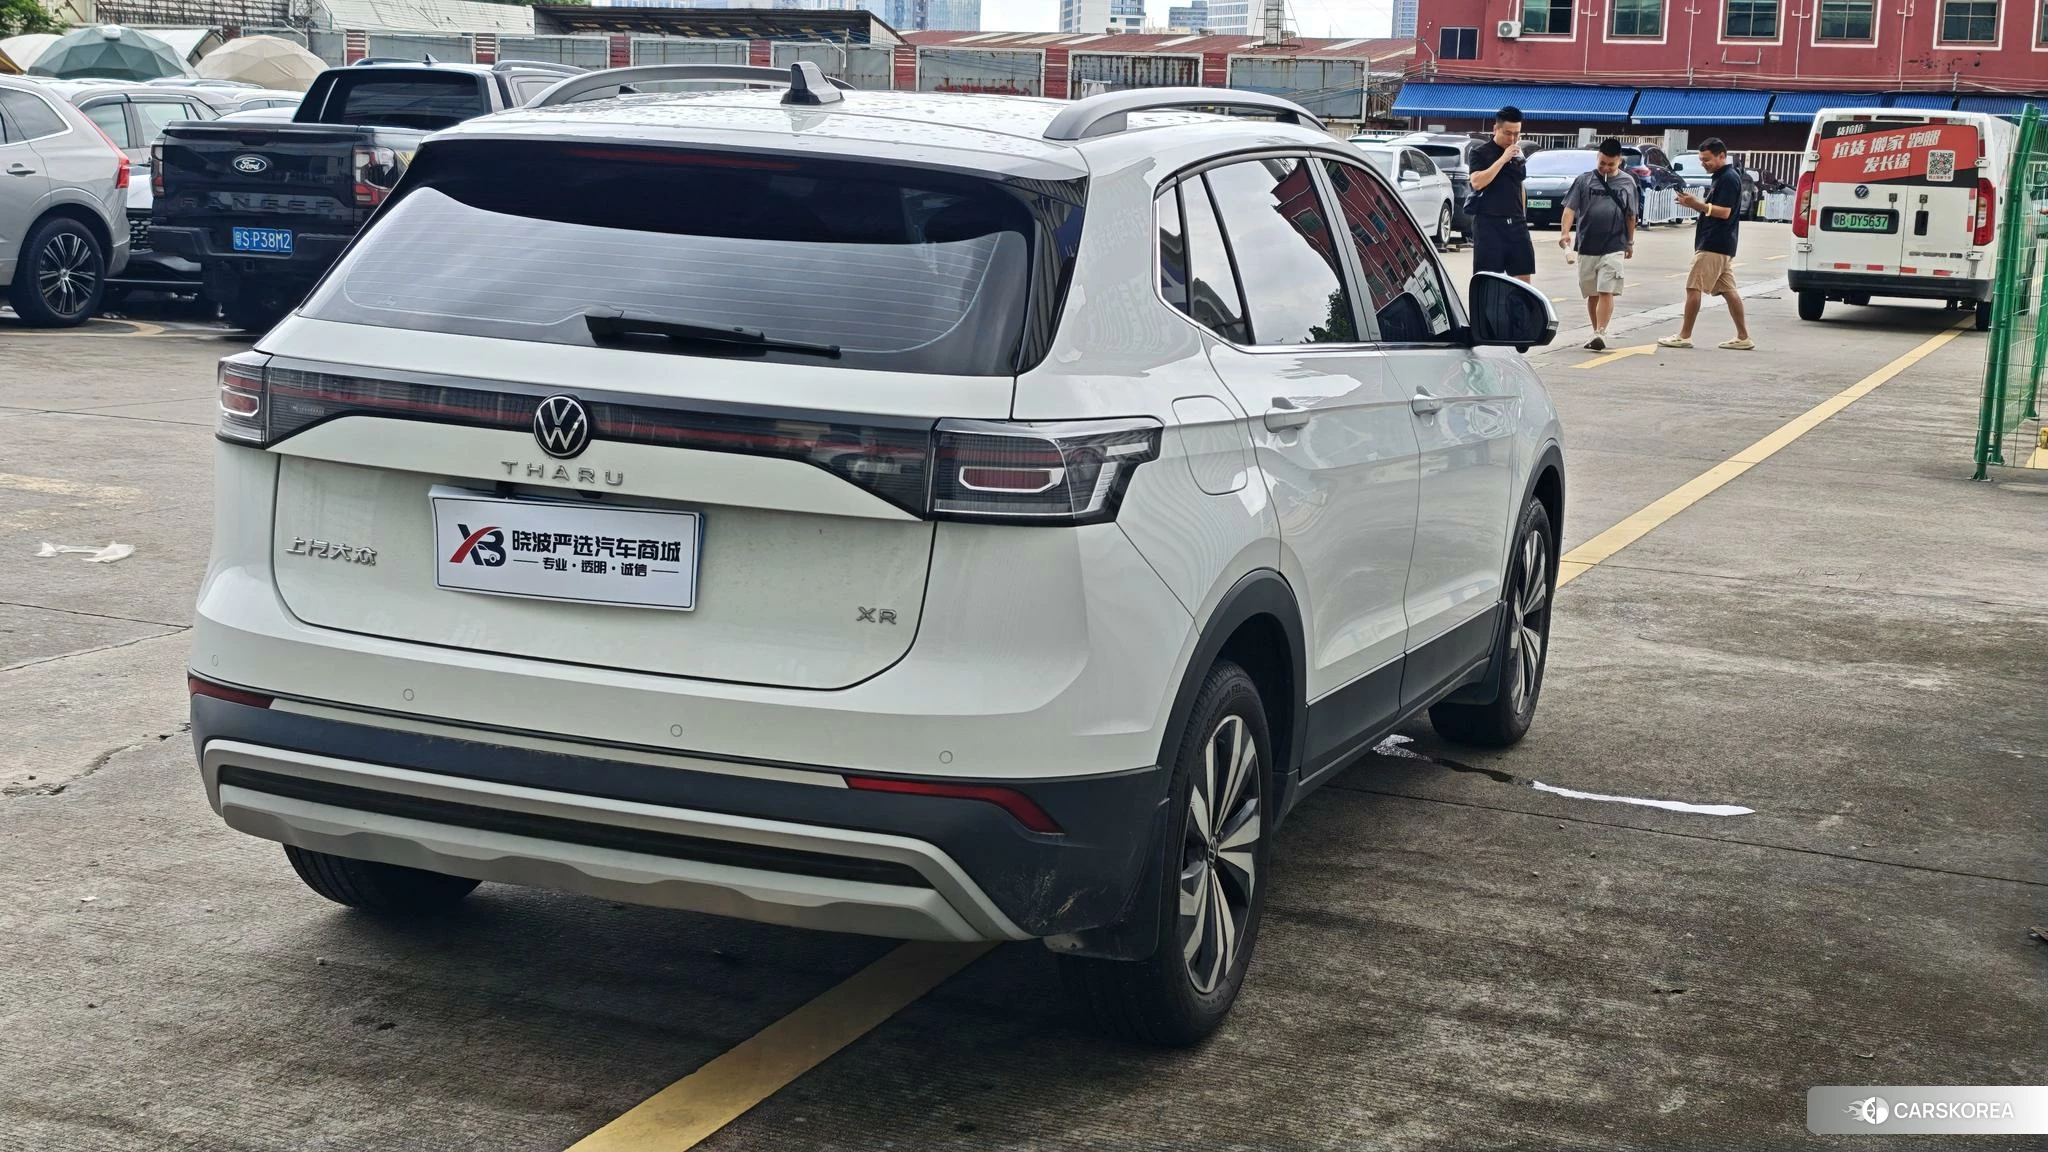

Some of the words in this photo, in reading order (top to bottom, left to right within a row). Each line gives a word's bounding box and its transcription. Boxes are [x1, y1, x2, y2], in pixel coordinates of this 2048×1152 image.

[1832, 140, 1865, 159] 拉货
[1870, 134, 1905, 154] 搬家
[1907, 129, 1942, 149] 跑腿
[240, 157, 261, 171] Ford
[1863, 153, 1911, 174] 发长途
[179, 196, 336, 214] RANGER
[501, 460, 624, 486] THARU
[284, 536, 378, 566] 上汽大众
[512, 530, 682, 563] 晓波严选汽车商城
[856, 606, 898, 625] XR
